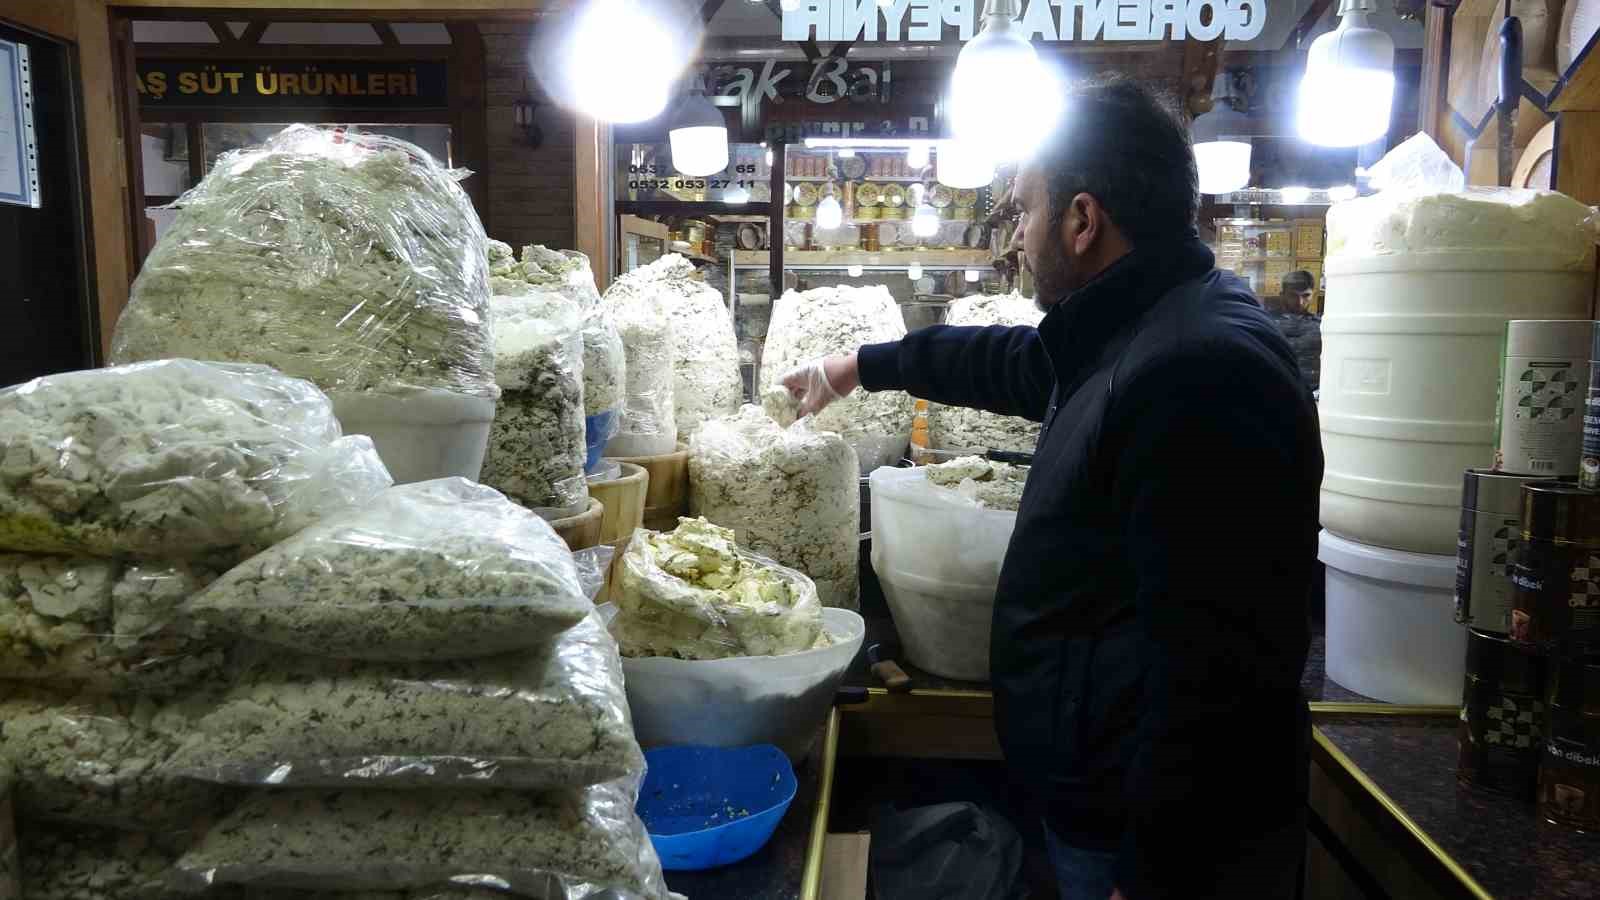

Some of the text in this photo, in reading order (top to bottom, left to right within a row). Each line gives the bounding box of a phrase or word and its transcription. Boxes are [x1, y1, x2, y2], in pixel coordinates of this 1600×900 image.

[179, 65, 244, 94] SÜT
[255, 65, 417, 96] ÜRÜNLERİ
[735, 164, 756, 174] 65
[630, 179, 669, 190] 0532
[675, 179, 705, 190] 053
[710, 179, 730, 190] 27
